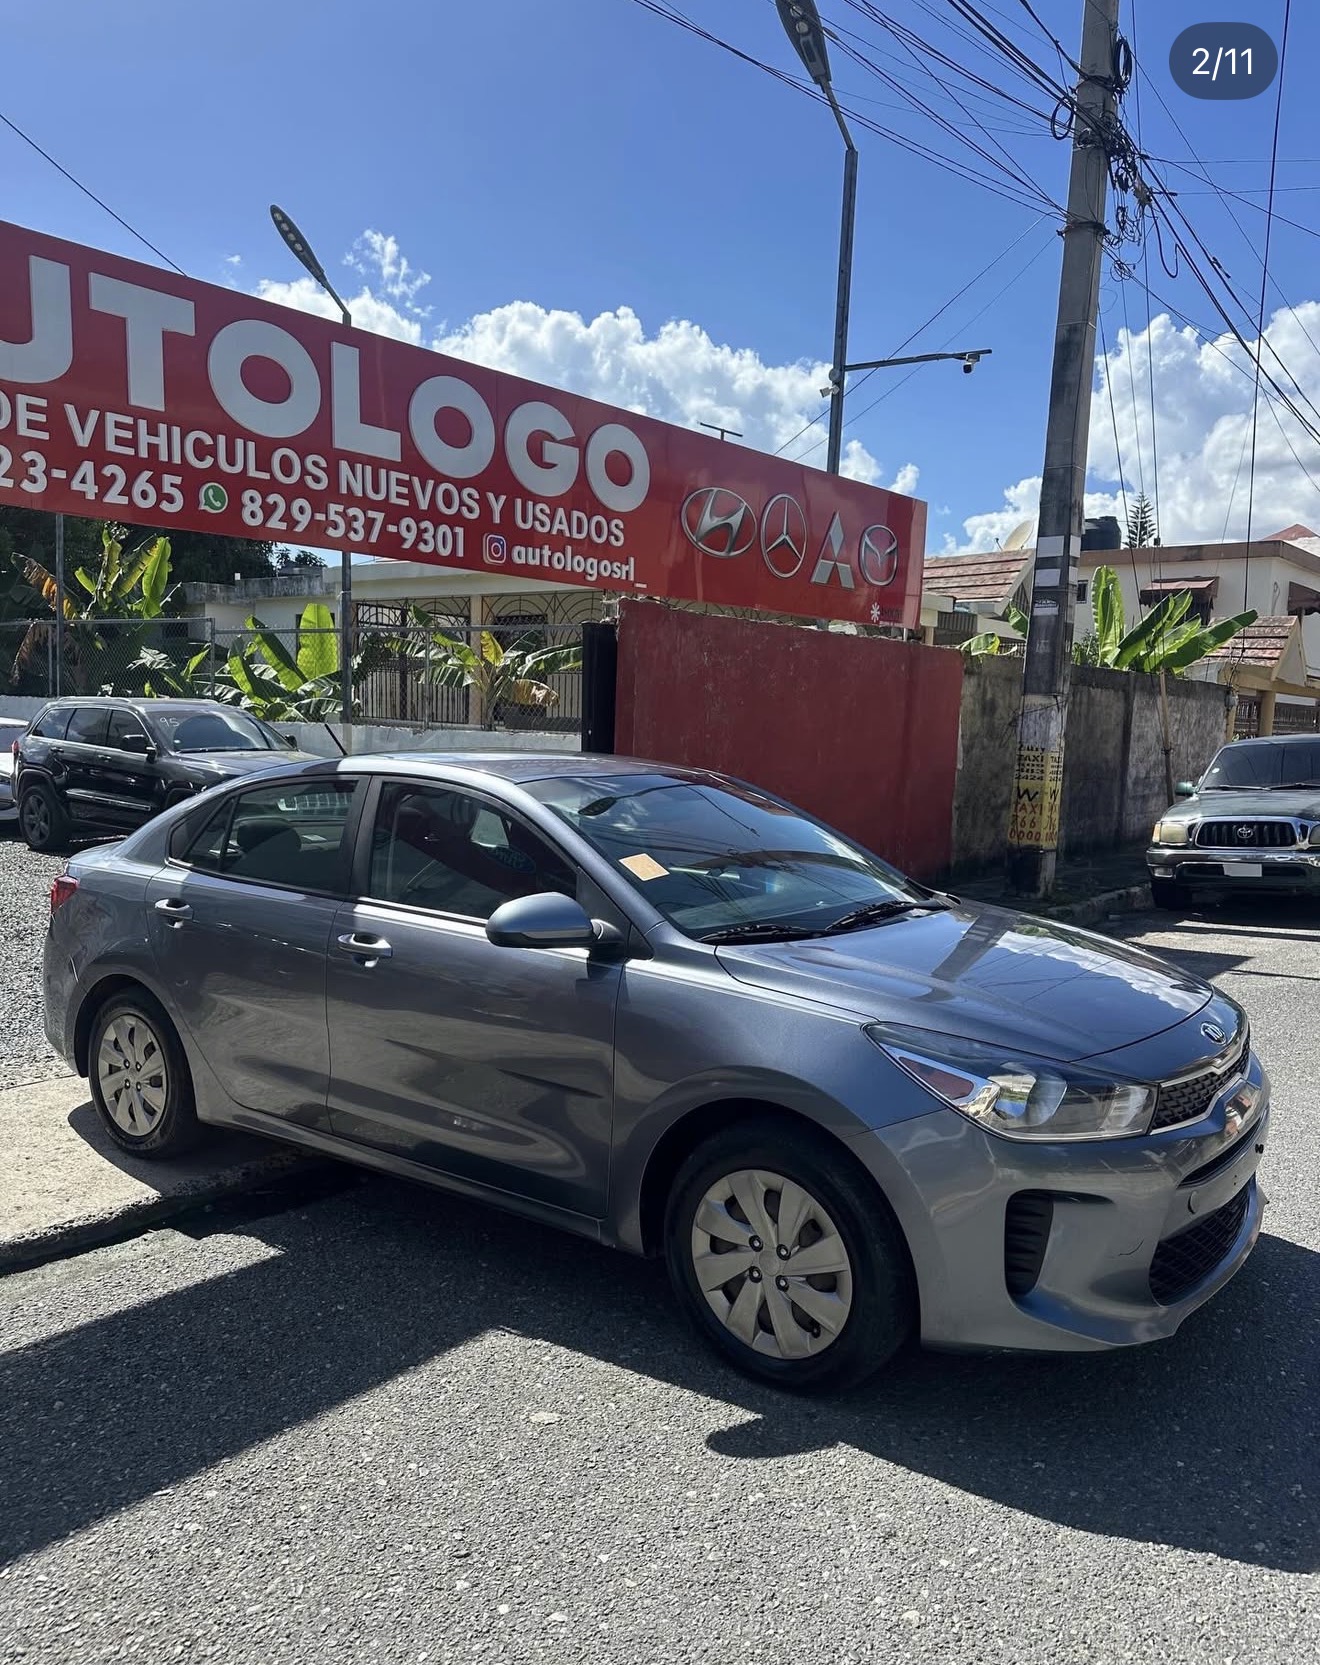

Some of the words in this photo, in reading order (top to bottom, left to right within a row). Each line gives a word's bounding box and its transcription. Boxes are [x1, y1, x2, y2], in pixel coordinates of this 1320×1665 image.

[64, 403, 329, 490] VEHICULOS
[339, 460, 480, 520] NUEVOS
[486, 491, 506, 524] Y
[514, 498, 625, 547] USADOS
[241, 488, 465, 558] 829-537-9301
[160, 717, 180, 727] 95
[1016, 753, 1044, 763] TAXI
[1017, 786, 1039, 802] W
[1014, 802, 1043, 816] TAXI
